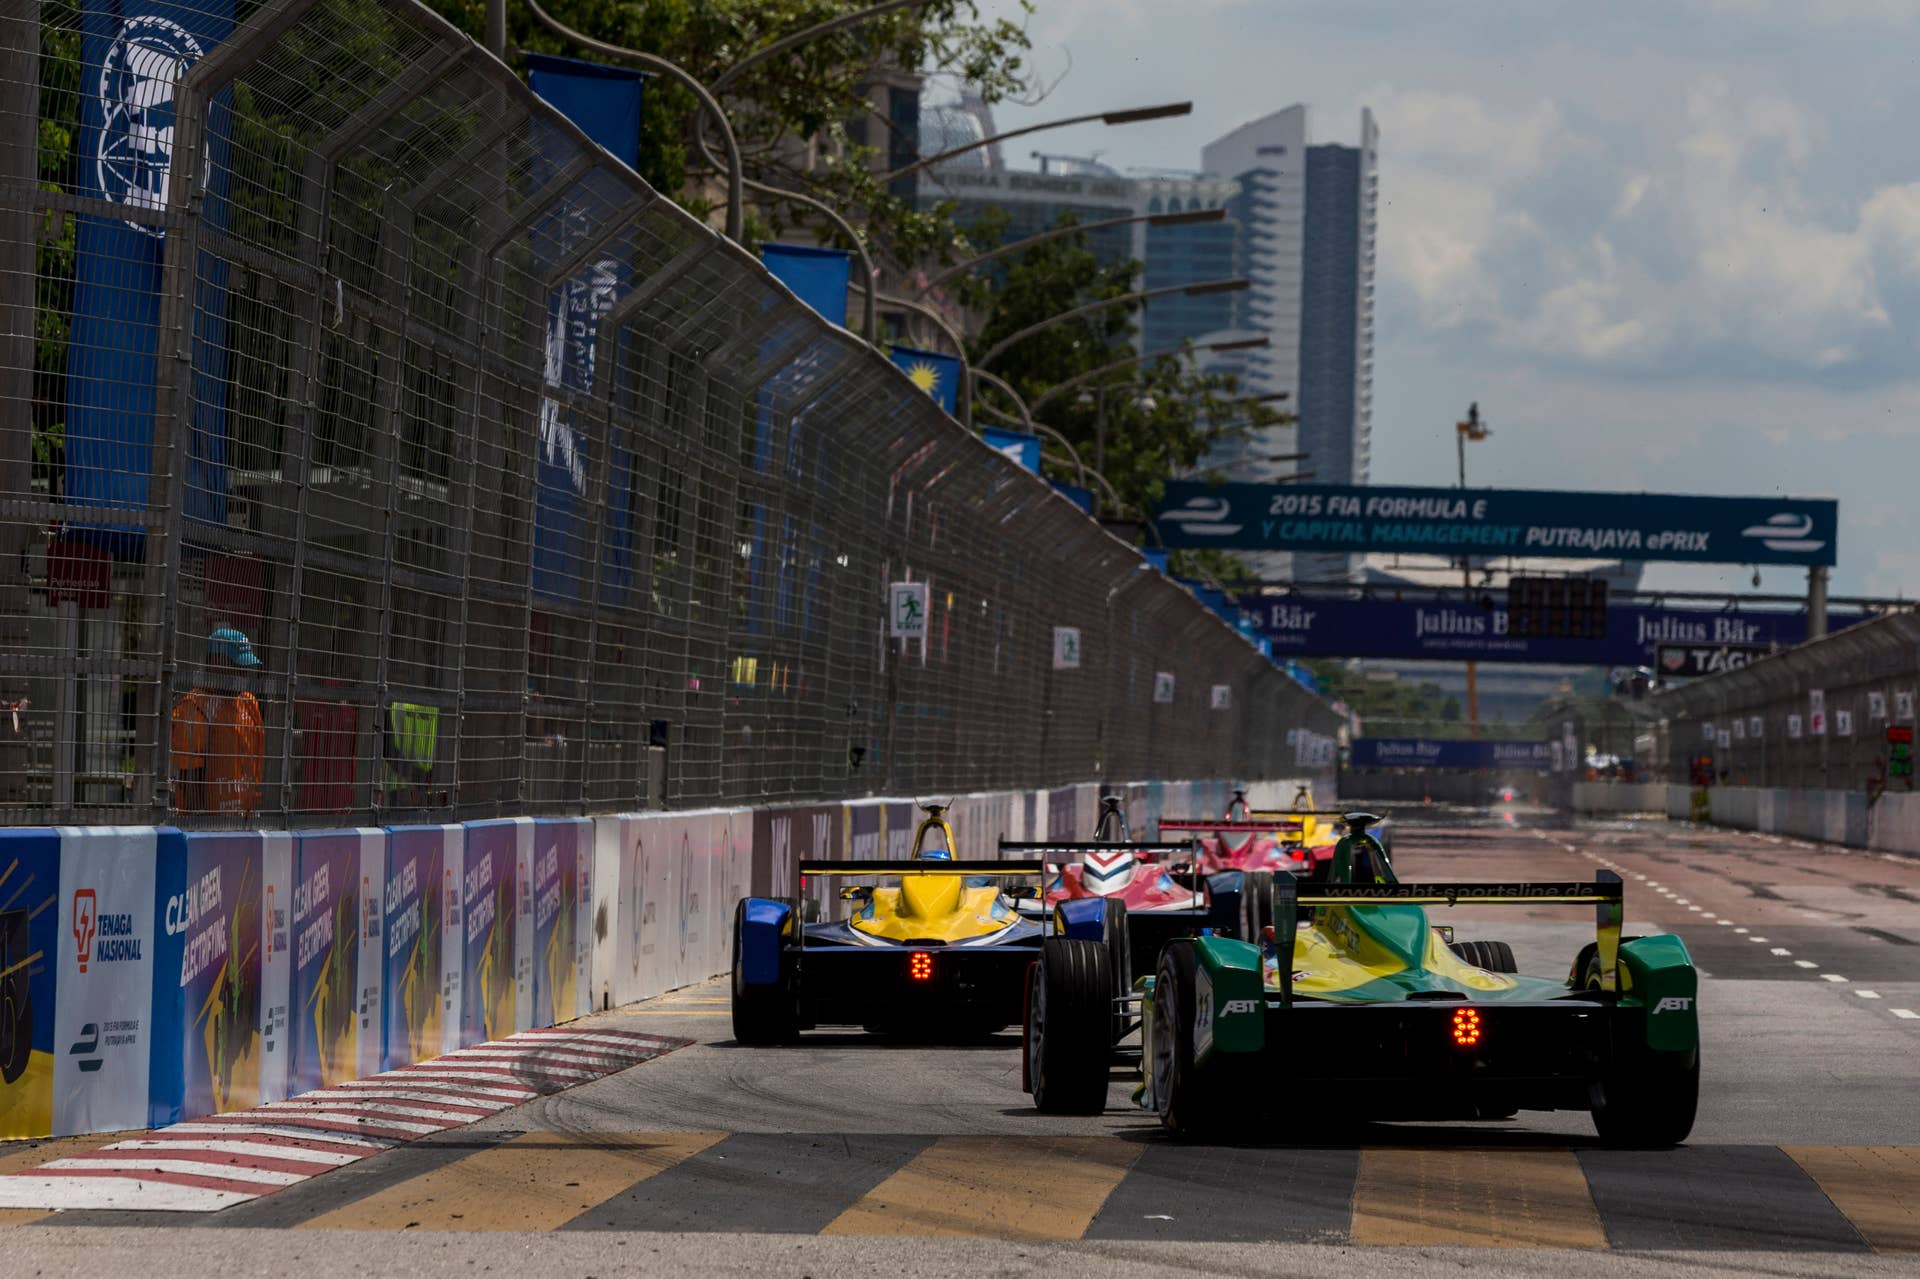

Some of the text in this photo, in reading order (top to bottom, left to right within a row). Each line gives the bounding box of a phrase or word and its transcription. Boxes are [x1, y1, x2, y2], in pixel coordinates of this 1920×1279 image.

[1270, 494, 1488, 519] 2015 FIA FORMULA E
[1280, 520, 1364, 542] CAPITAL
[1372, 522, 1521, 546] MANAGEMENT
[1525, 526, 1642, 550] PUTRAJAYA
[1646, 530, 1711, 552] ePRIX
[1271, 605, 1316, 631] Bär
[1415, 608, 1486, 638] Julius
[1636, 614, 1760, 645] Julius Bär
[1692, 649, 1746, 673] TAG
[1324, 882, 1594, 897] www.abt-sportsline.de
[98, 914, 132, 937] TENAGA
[97, 939, 142, 962] NASIONAL
[1218, 999, 1260, 1018] ABT
[1652, 997, 1693, 1014] ABT
